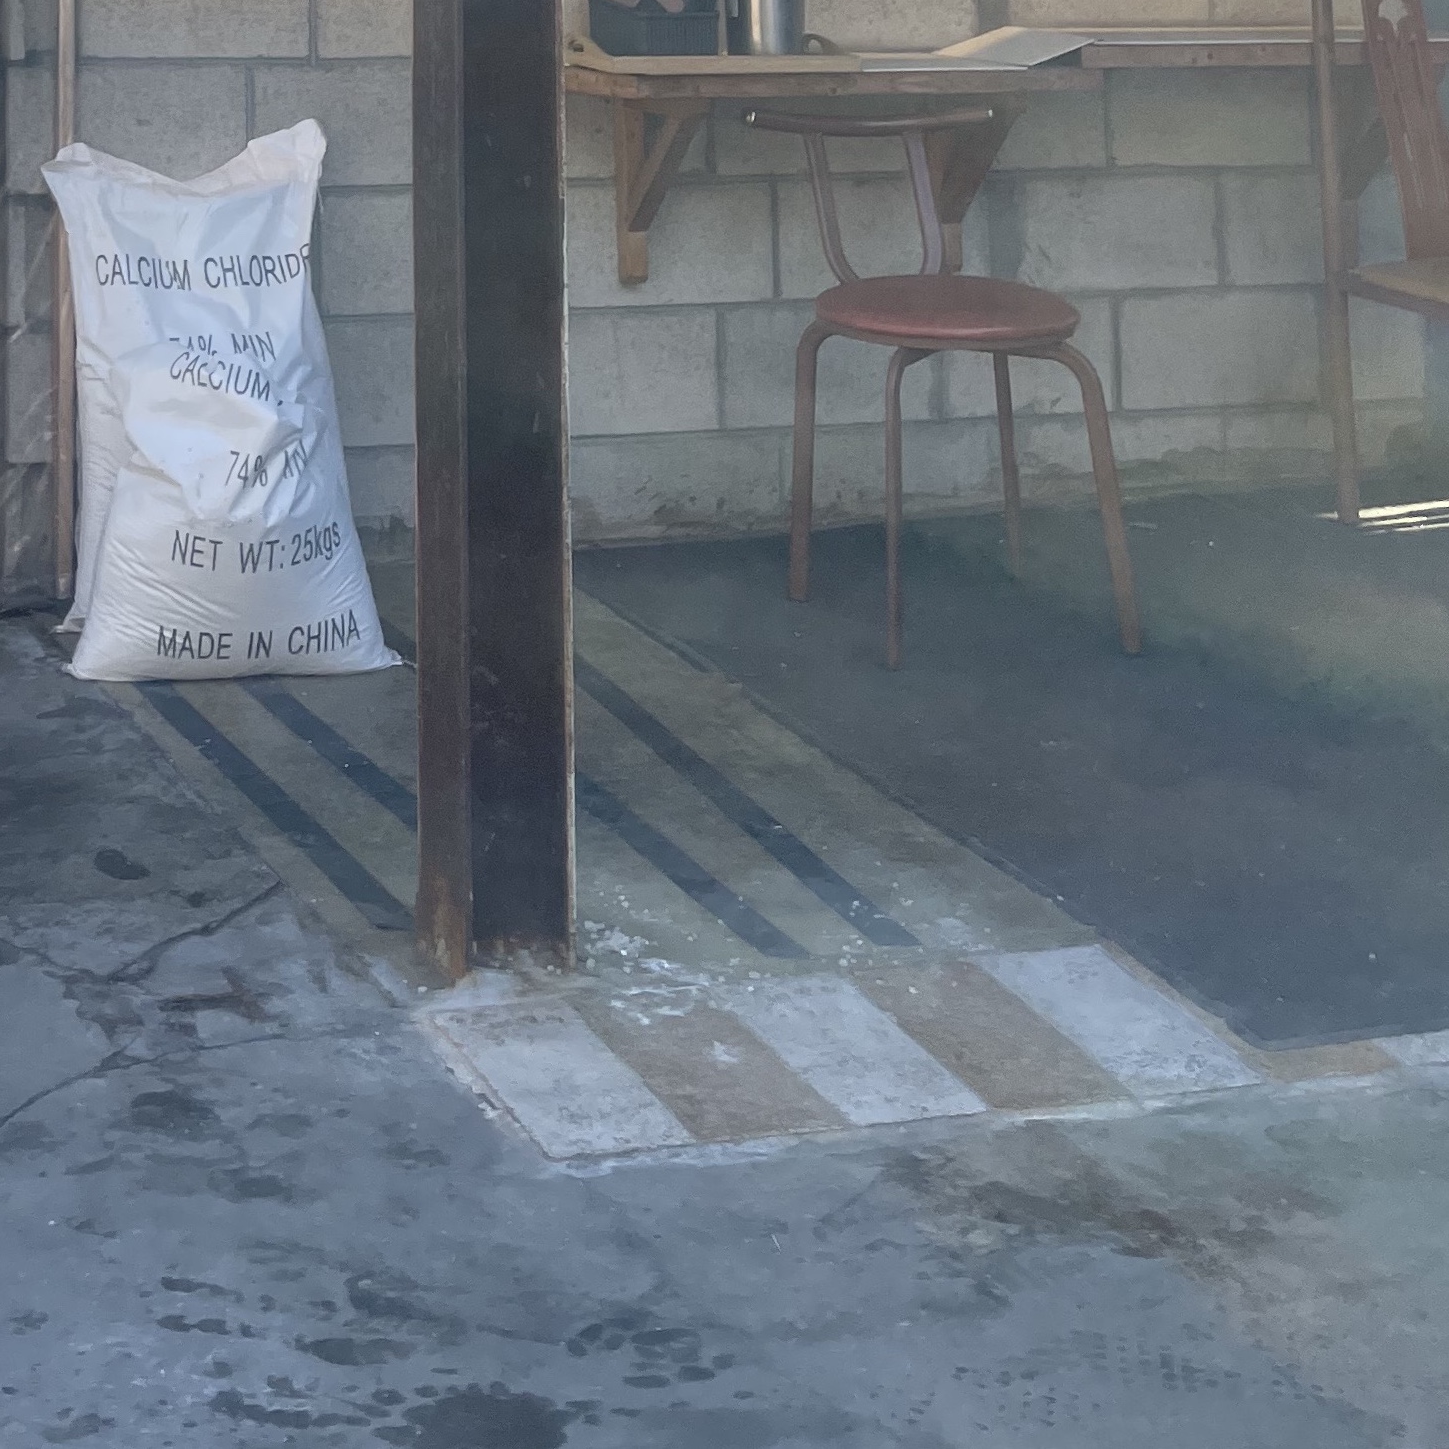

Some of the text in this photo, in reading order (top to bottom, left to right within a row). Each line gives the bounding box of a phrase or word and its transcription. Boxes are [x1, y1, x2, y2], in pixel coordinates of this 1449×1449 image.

[96, 254, 192, 291] CALCIUM
[170, 351, 270, 401] CALCIUM
[224, 450, 268, 489] 74%
[171, 521, 341, 574] NET WT: 25kgs
[157, 609, 360, 660] MADE IN CHINA
